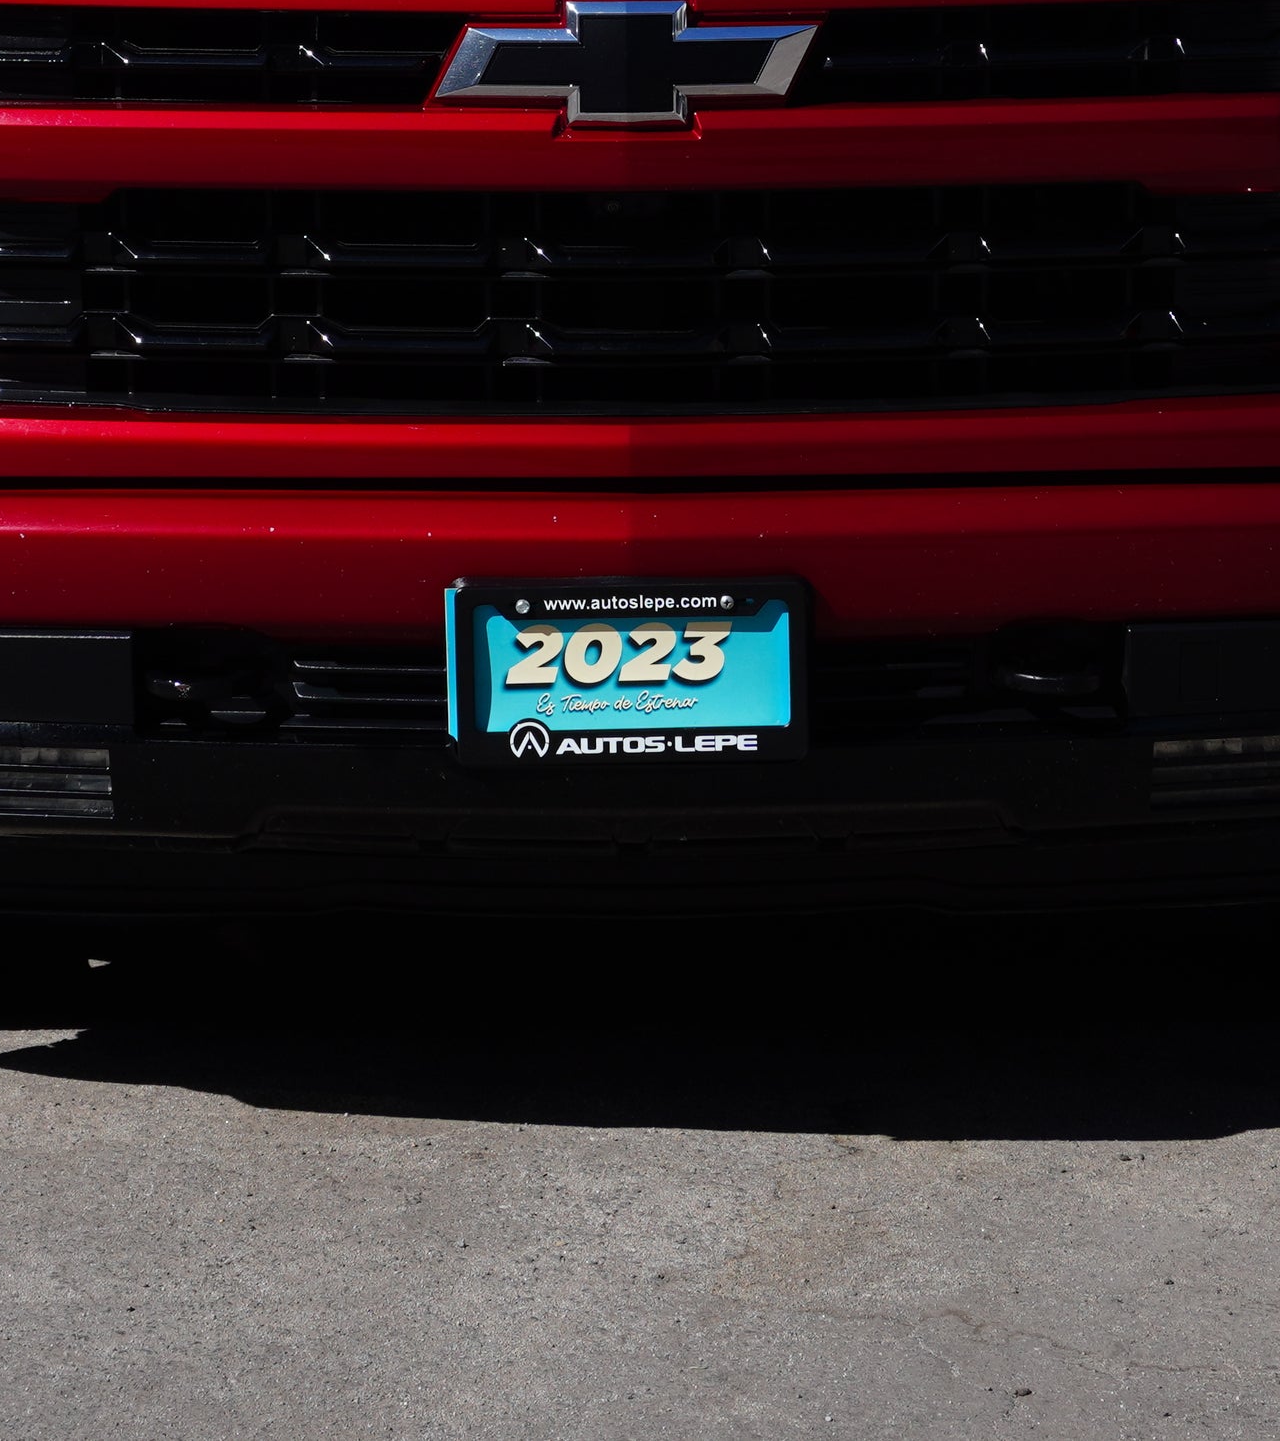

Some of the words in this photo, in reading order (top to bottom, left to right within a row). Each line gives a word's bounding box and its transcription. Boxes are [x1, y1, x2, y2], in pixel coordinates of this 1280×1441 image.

[544, 595, 718, 612] www.autoslepe.com
[506, 621, 732, 685] 2023
[536, 692, 556, 715] Es
[560, 694, 610, 714] Tiempo
[614, 695, 633, 711] de
[635, 690, 699, 714] Estrenar
